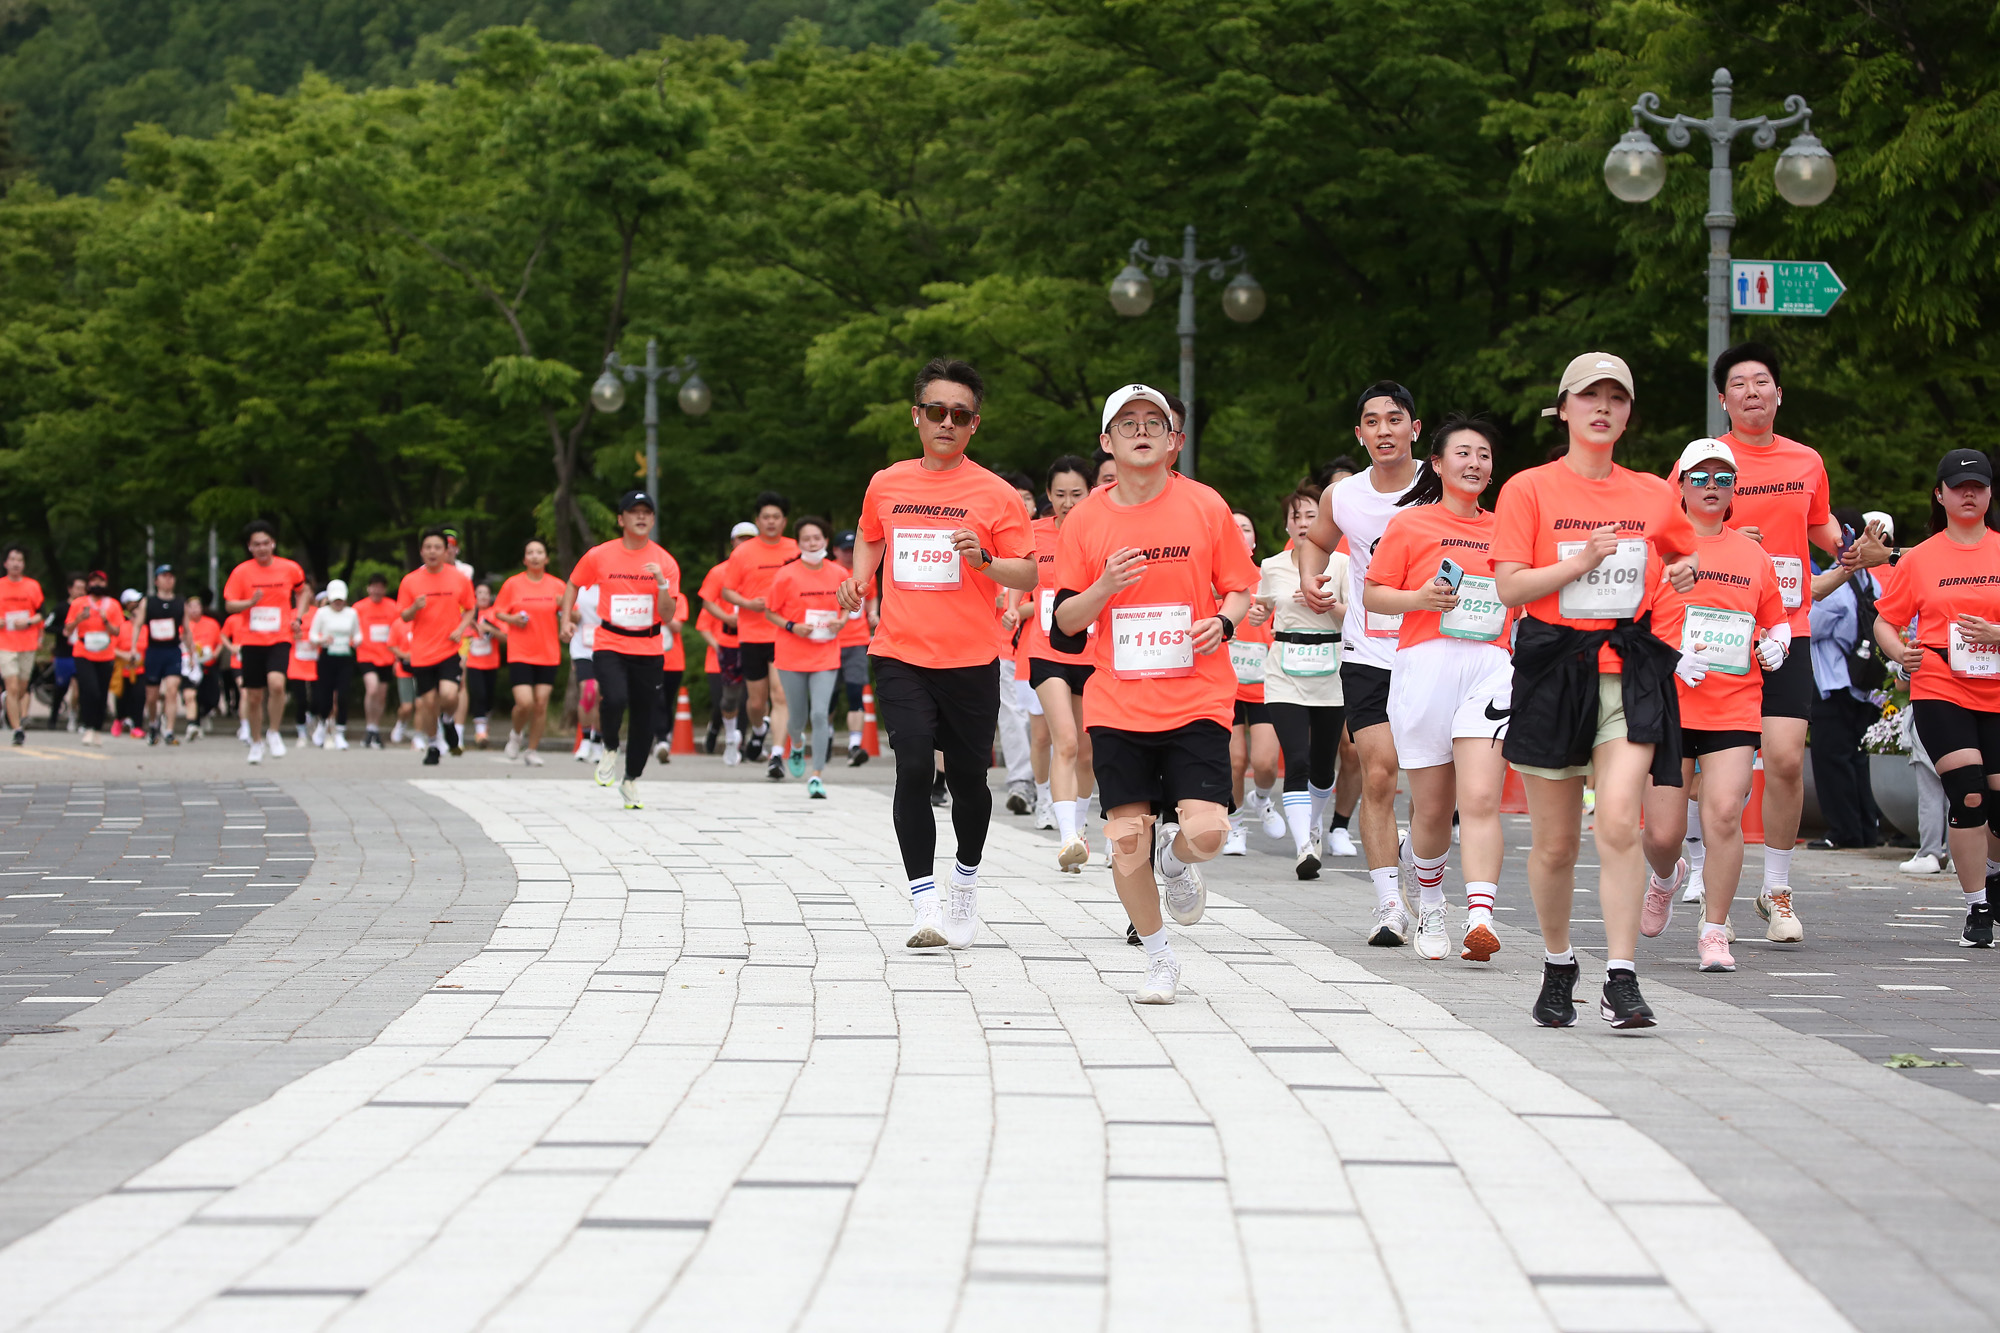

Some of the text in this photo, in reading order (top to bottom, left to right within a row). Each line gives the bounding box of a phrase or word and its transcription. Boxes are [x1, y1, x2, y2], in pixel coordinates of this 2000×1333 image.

[1781, 280, 1816, 288] TOILET
[1738, 482, 1804, 496] BURNING RUN
[892, 504, 969, 518] BURNING RUN
[1618, 521, 1645, 531] RUN
[1441, 539, 1490, 551] BURNING
[898, 550, 954, 563] M 1599
[1162, 546, 1191, 558] RUN
[1587, 568, 1639, 586] 6109
[1697, 571, 1751, 586] RNING RUN
[1939, 576, 2000, 587] BURNING RU
[624, 607, 649, 615] 1544
[1462, 599, 1503, 614] 8257
[1119, 629, 1184, 647] M 1163
[1690, 630, 1745, 647] W 8400
[1297, 646, 1330, 656] 8115
[1956, 643, 1966, 651] W
[1231, 656, 1261, 667] 8146
[1969, 664, 1990, 672] B-367
